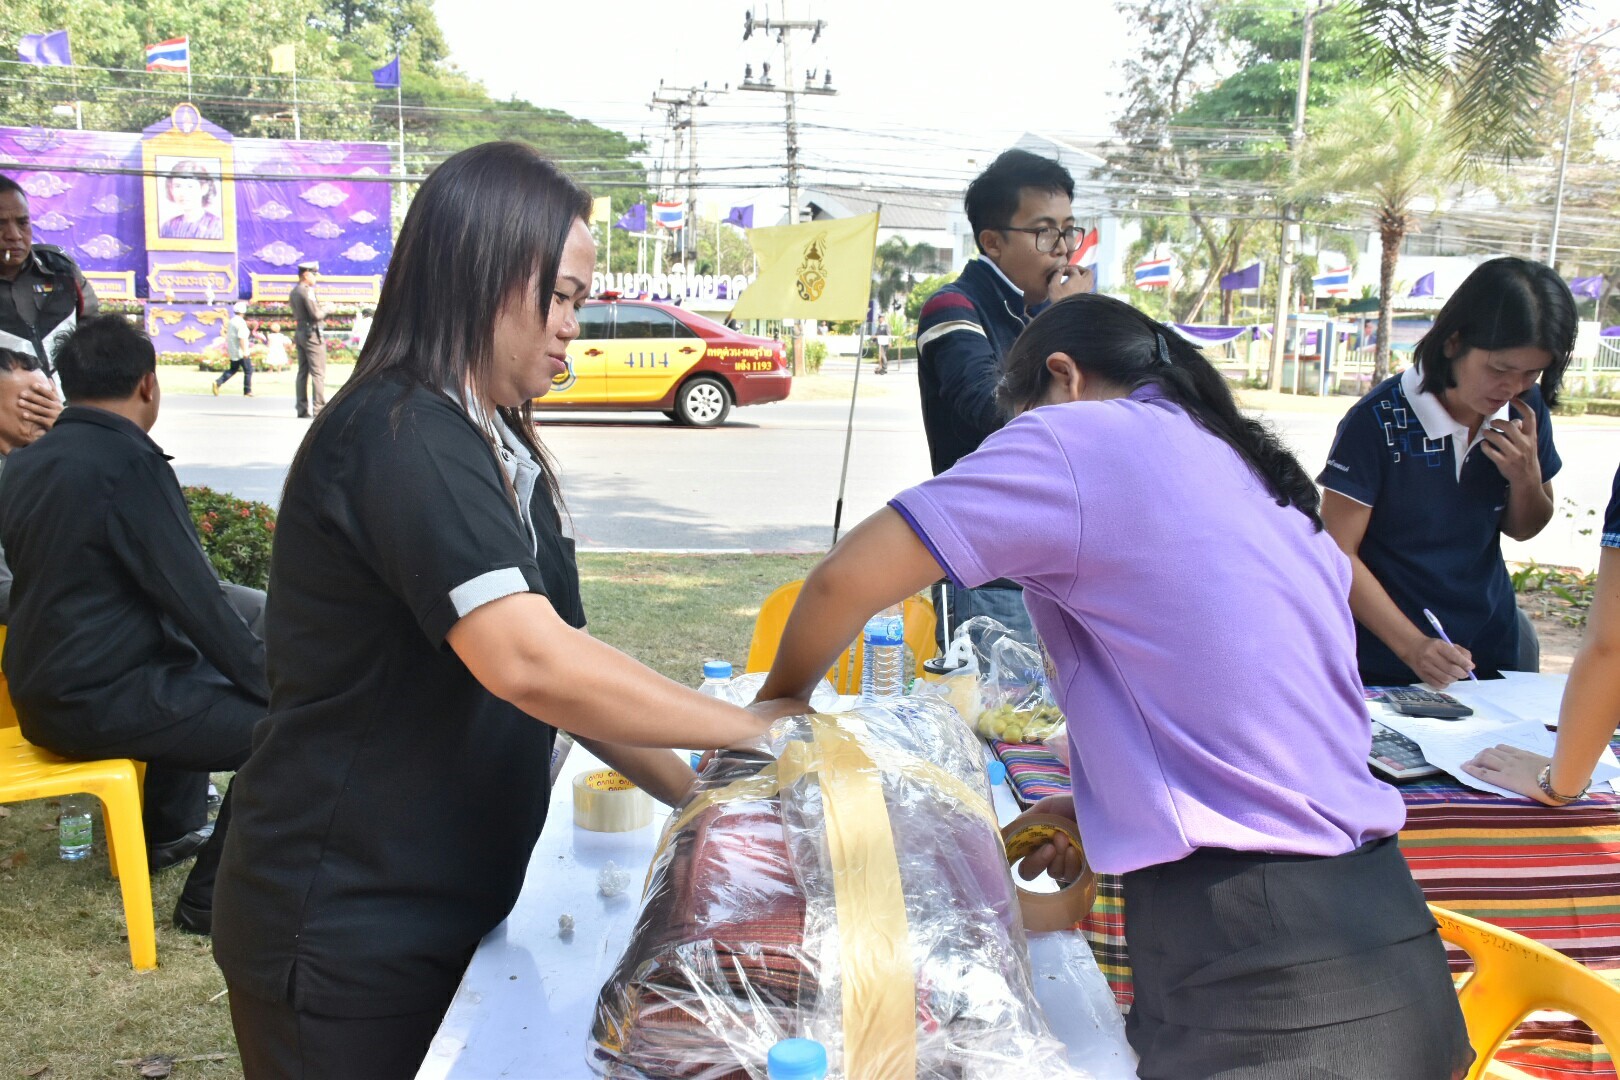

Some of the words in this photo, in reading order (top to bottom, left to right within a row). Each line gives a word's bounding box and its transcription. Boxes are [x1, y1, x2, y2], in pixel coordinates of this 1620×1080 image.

[624, 352, 668, 368] 4114
[734, 359, 751, 371] แจ้ง
[753, 361, 772, 371] 1193
